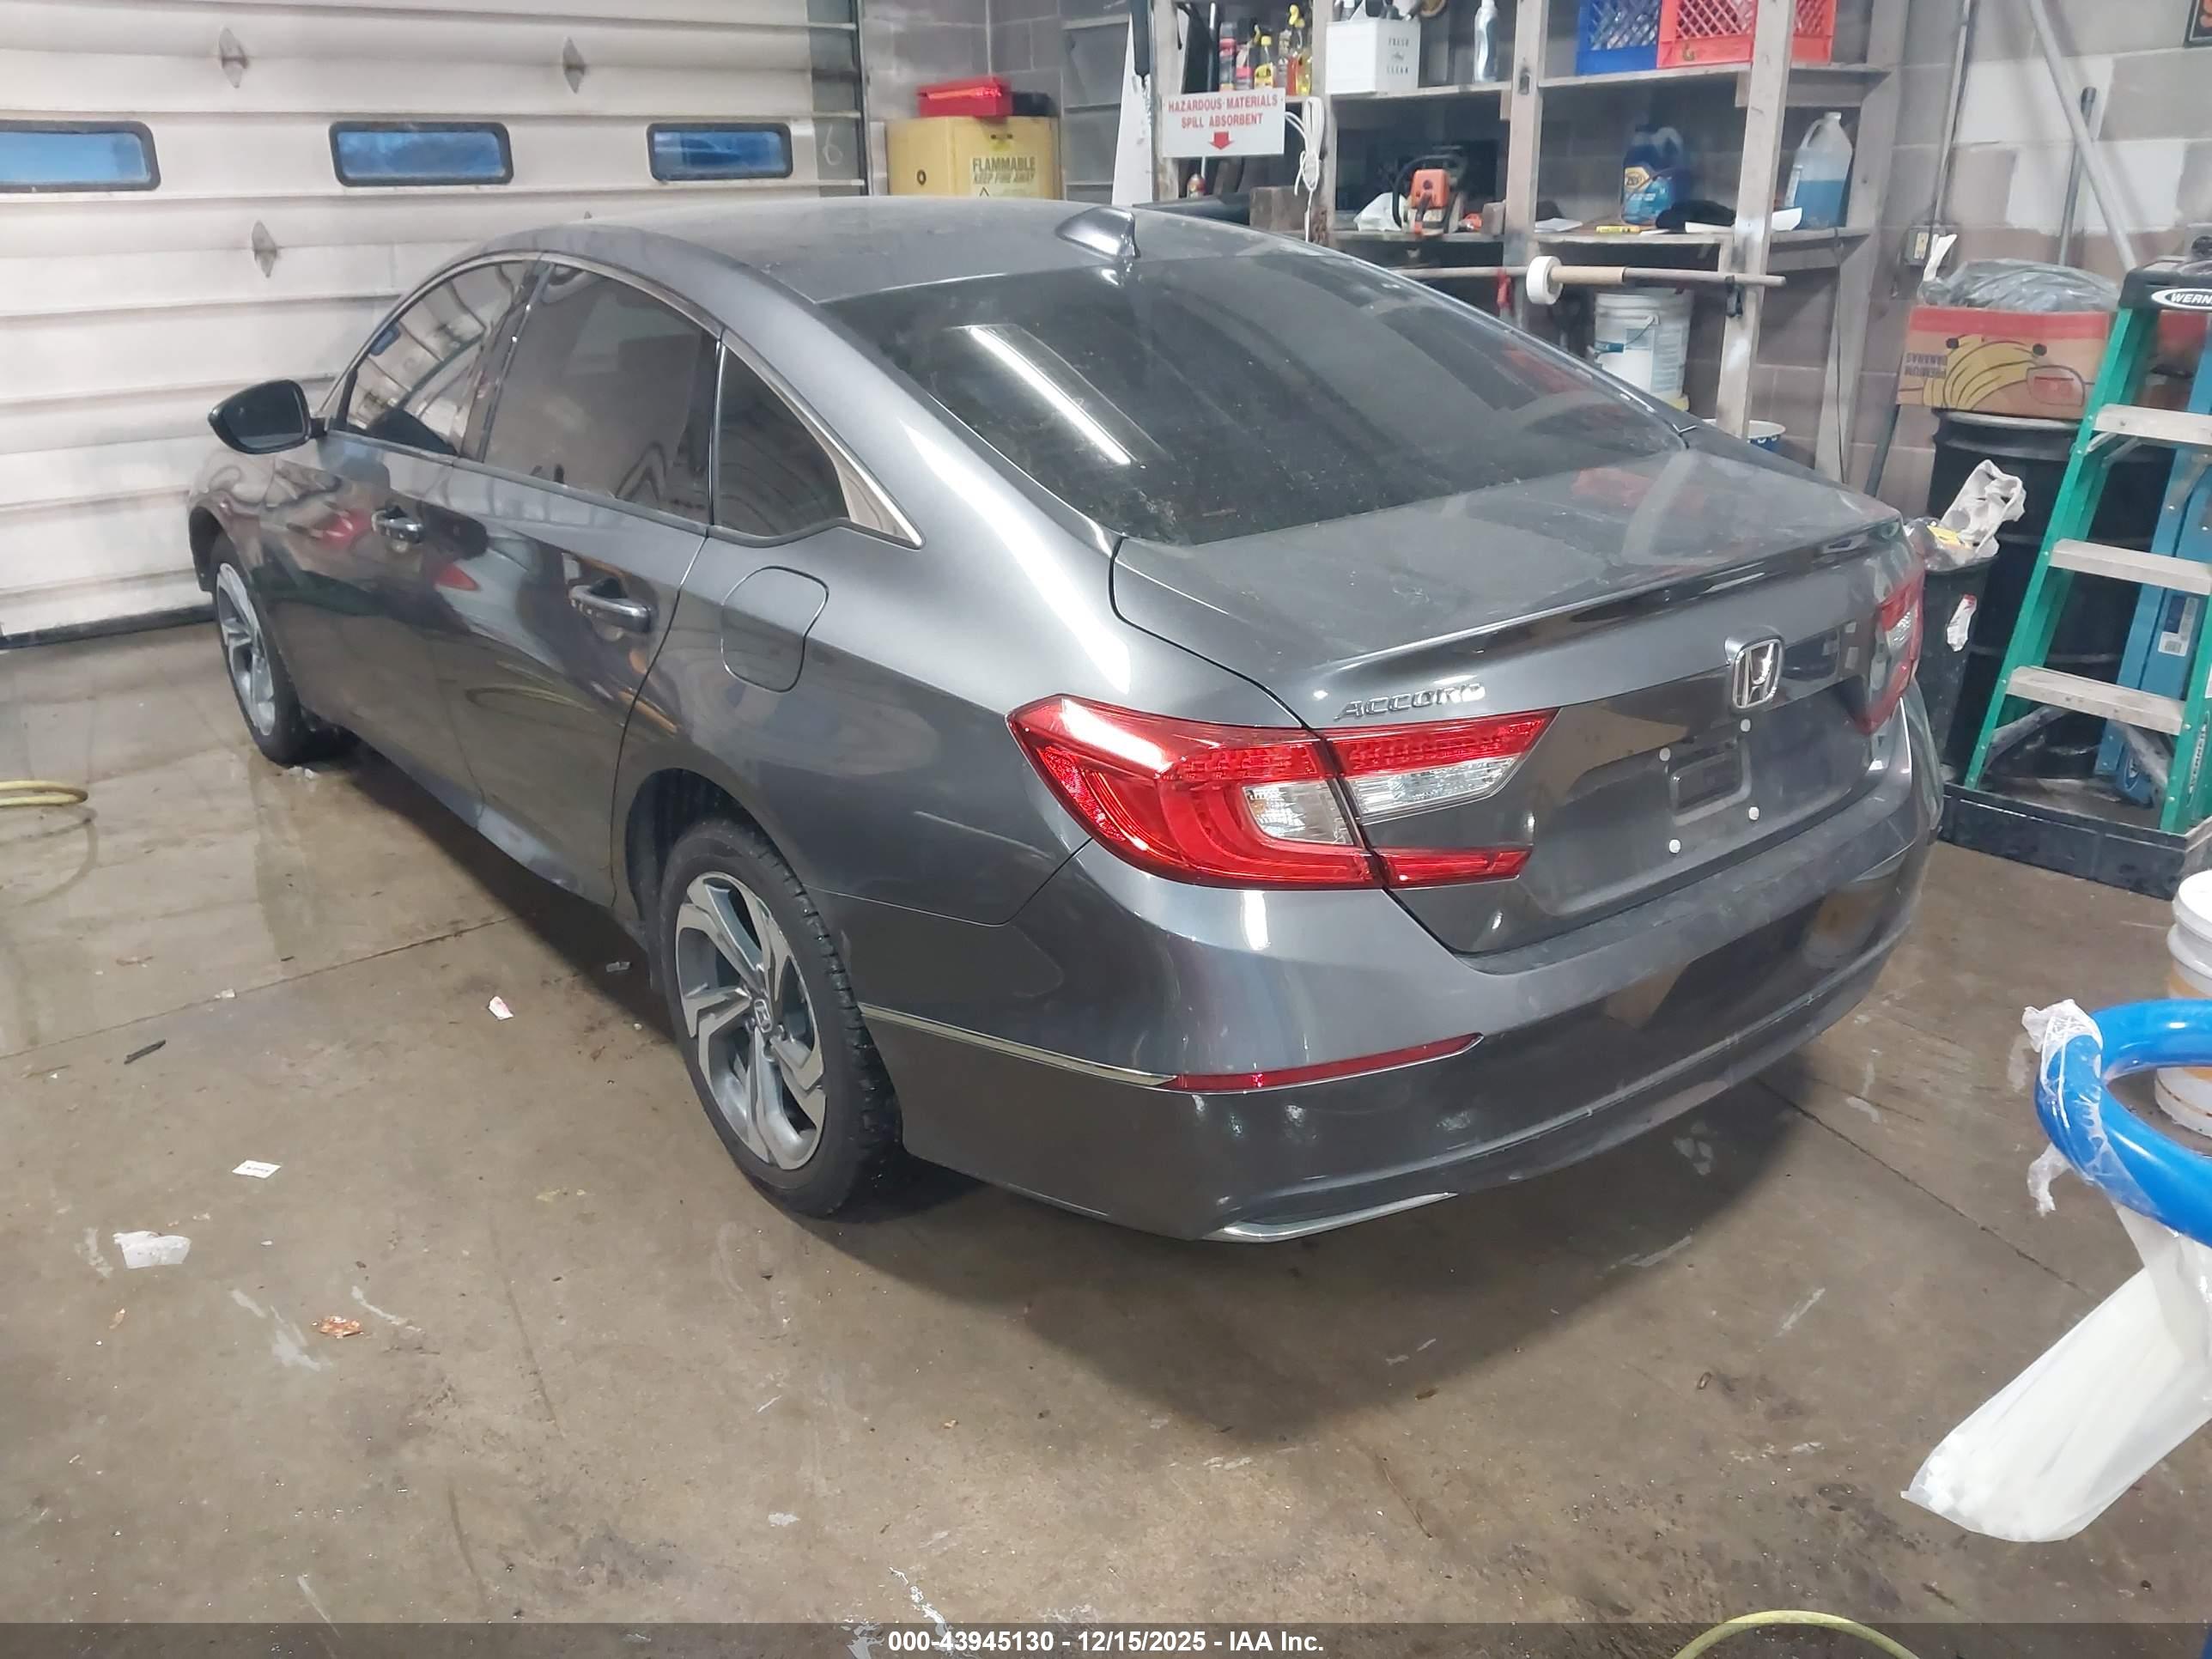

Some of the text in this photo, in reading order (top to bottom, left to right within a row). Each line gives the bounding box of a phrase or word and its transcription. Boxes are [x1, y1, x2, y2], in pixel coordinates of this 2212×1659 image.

[1168, 94, 1278, 112] HAZARDOUS MATERIALS
[1181, 112, 1263, 129] SPILL ABSORBENT
[972, 156, 1036, 172] FLAMMABLE
[2171, 293, 2212, 304] WERN
[1334, 683, 1486, 721] ACCORD
